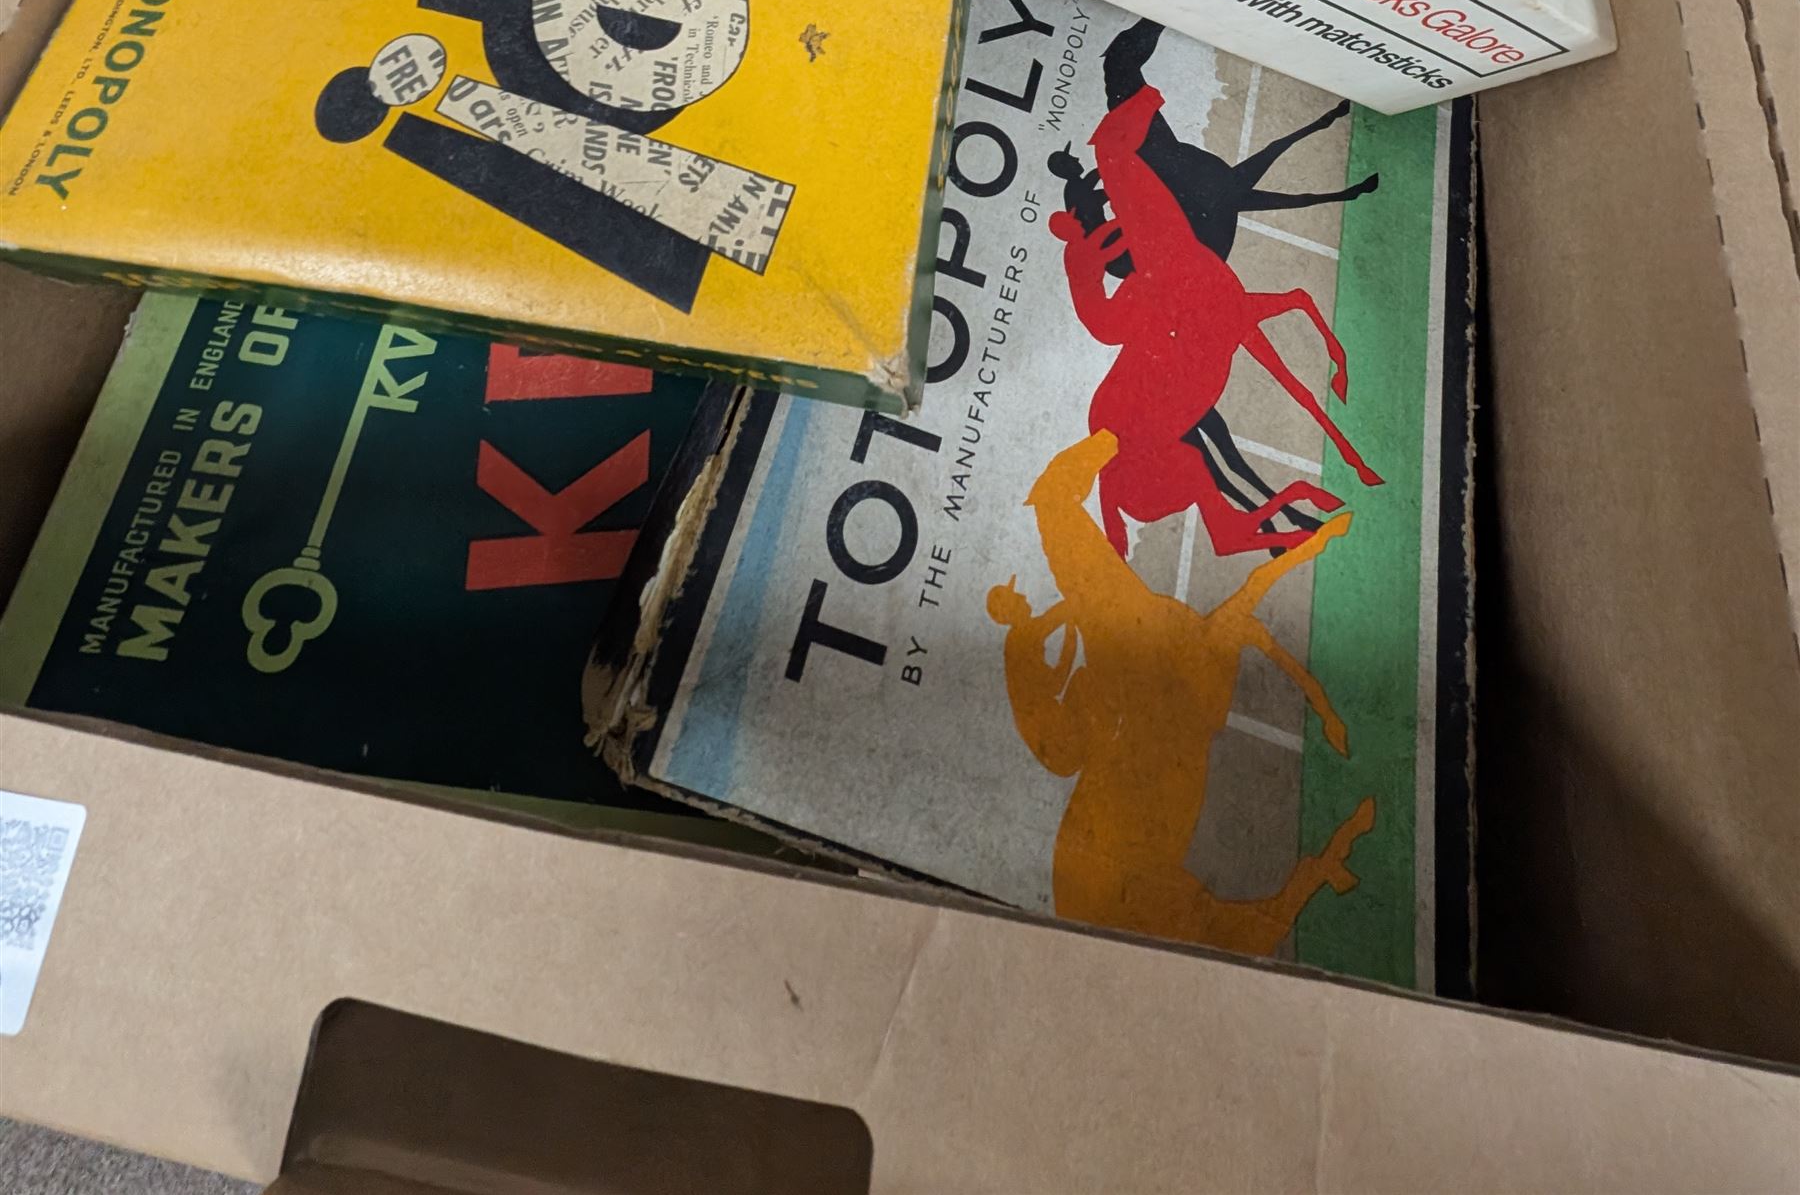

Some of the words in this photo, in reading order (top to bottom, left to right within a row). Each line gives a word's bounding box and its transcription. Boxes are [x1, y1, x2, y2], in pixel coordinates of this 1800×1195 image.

[1294, 12, 1454, 90] matchsticks
[1420, 8, 1525, 66] Galore
[49, 90, 76, 126] LEEDS
[8, 140, 46, 197] LONDON
[901, 635, 928, 687] BY
[919, 544, 954, 609] THE
[942, 244, 1030, 522] MANUFACTURERS
[1019, 189, 1042, 224] OF
[115, 399, 264, 663] MAKERS
[237, 301, 300, 368] OF
[79, 449, 183, 656] MANUFACTURED
[172, 406, 200, 432] IN
